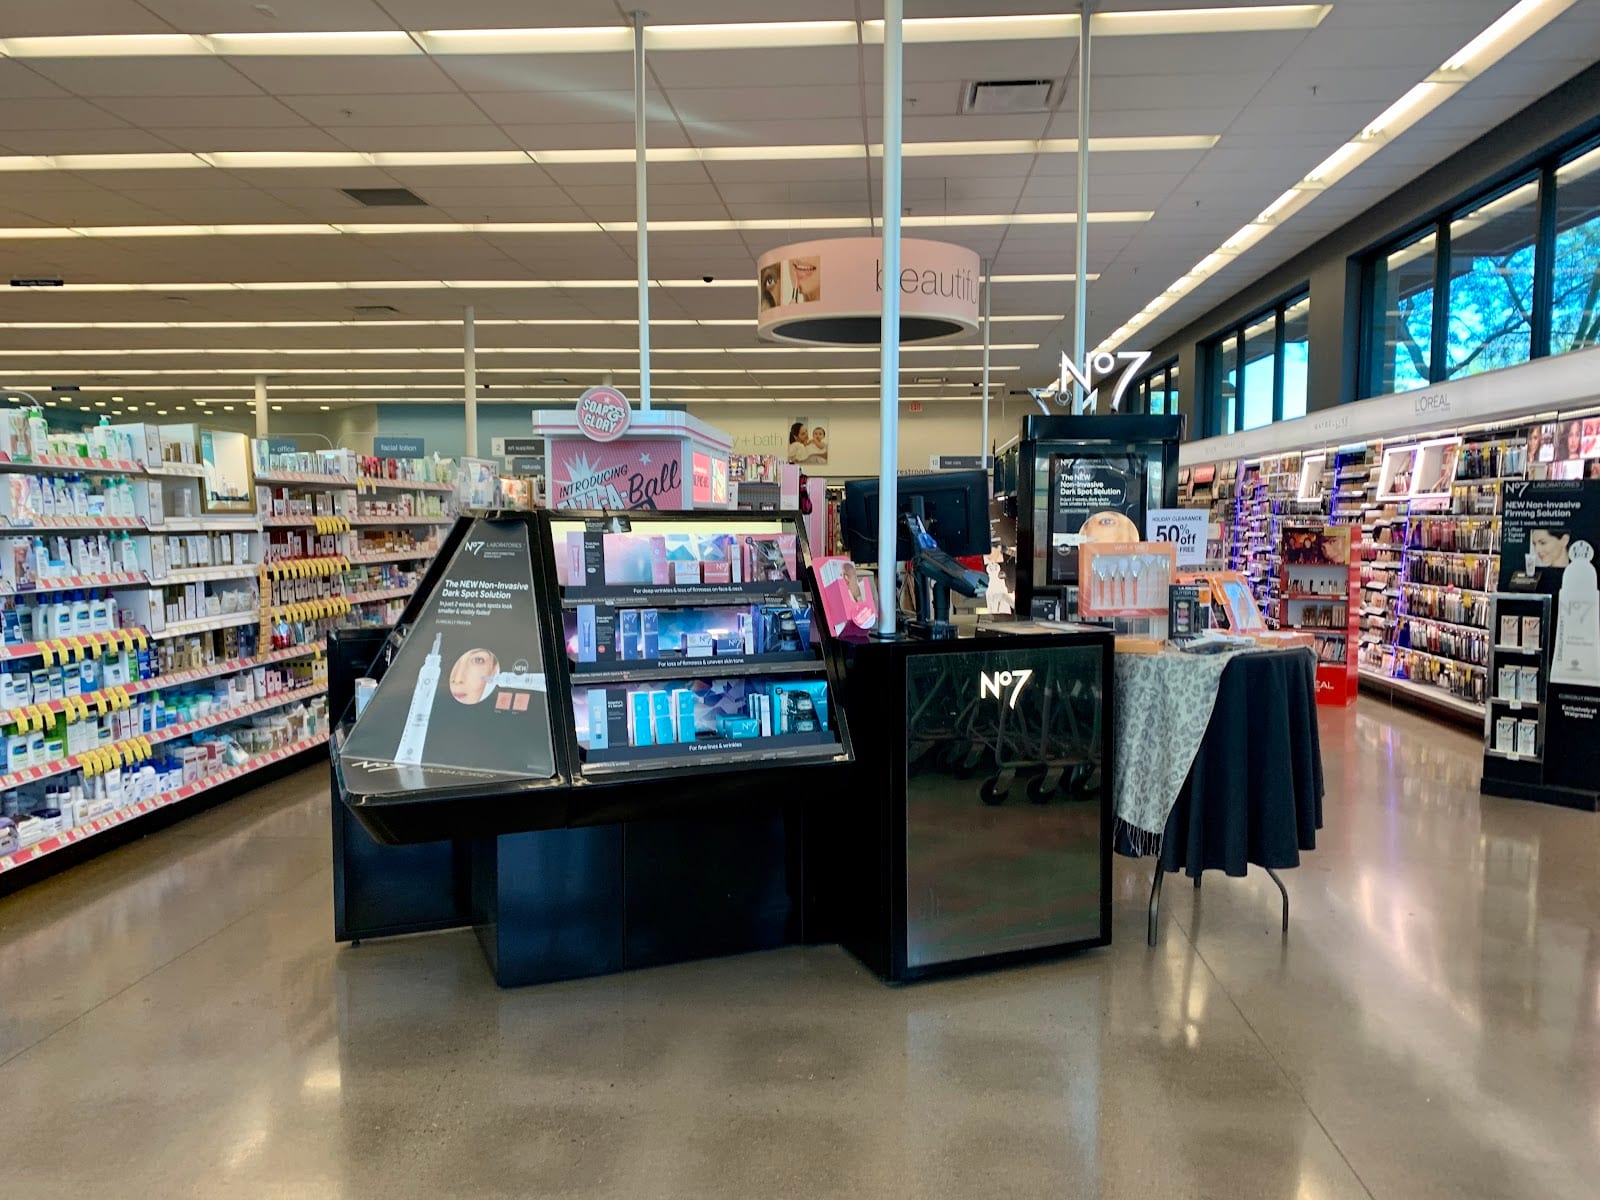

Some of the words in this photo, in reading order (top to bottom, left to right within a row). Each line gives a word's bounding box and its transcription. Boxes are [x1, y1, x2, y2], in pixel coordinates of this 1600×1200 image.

[582, 399, 609, 416] SOAP
[584, 413, 617, 433] GLORY
[753, 432, 783, 446] bath
[559, 464, 629, 498] INTRODUCING
[628, 459, 681, 504] Ball
[1077, 488, 1093, 496] Spot
[1505, 501, 1525, 509] NEW
[1526, 501, 1581, 509] Non-Invasive
[1505, 509, 1535, 518] Firming
[1536, 509, 1571, 517] Solution
[1180, 533, 1196, 544] off
[445, 579, 459, 588] The
[459, 580, 478, 588] NEW
[479, 581, 529, 590] Non-Invasive
[441, 589, 460, 597] Dark
[460, 590, 479, 599] Spot
[480, 591, 512, 599] Solution
[513, 664, 528, 672] NEW
[1561, 704, 1590, 714] Exclusively
[1564, 710, 1593, 719] Walgreens
